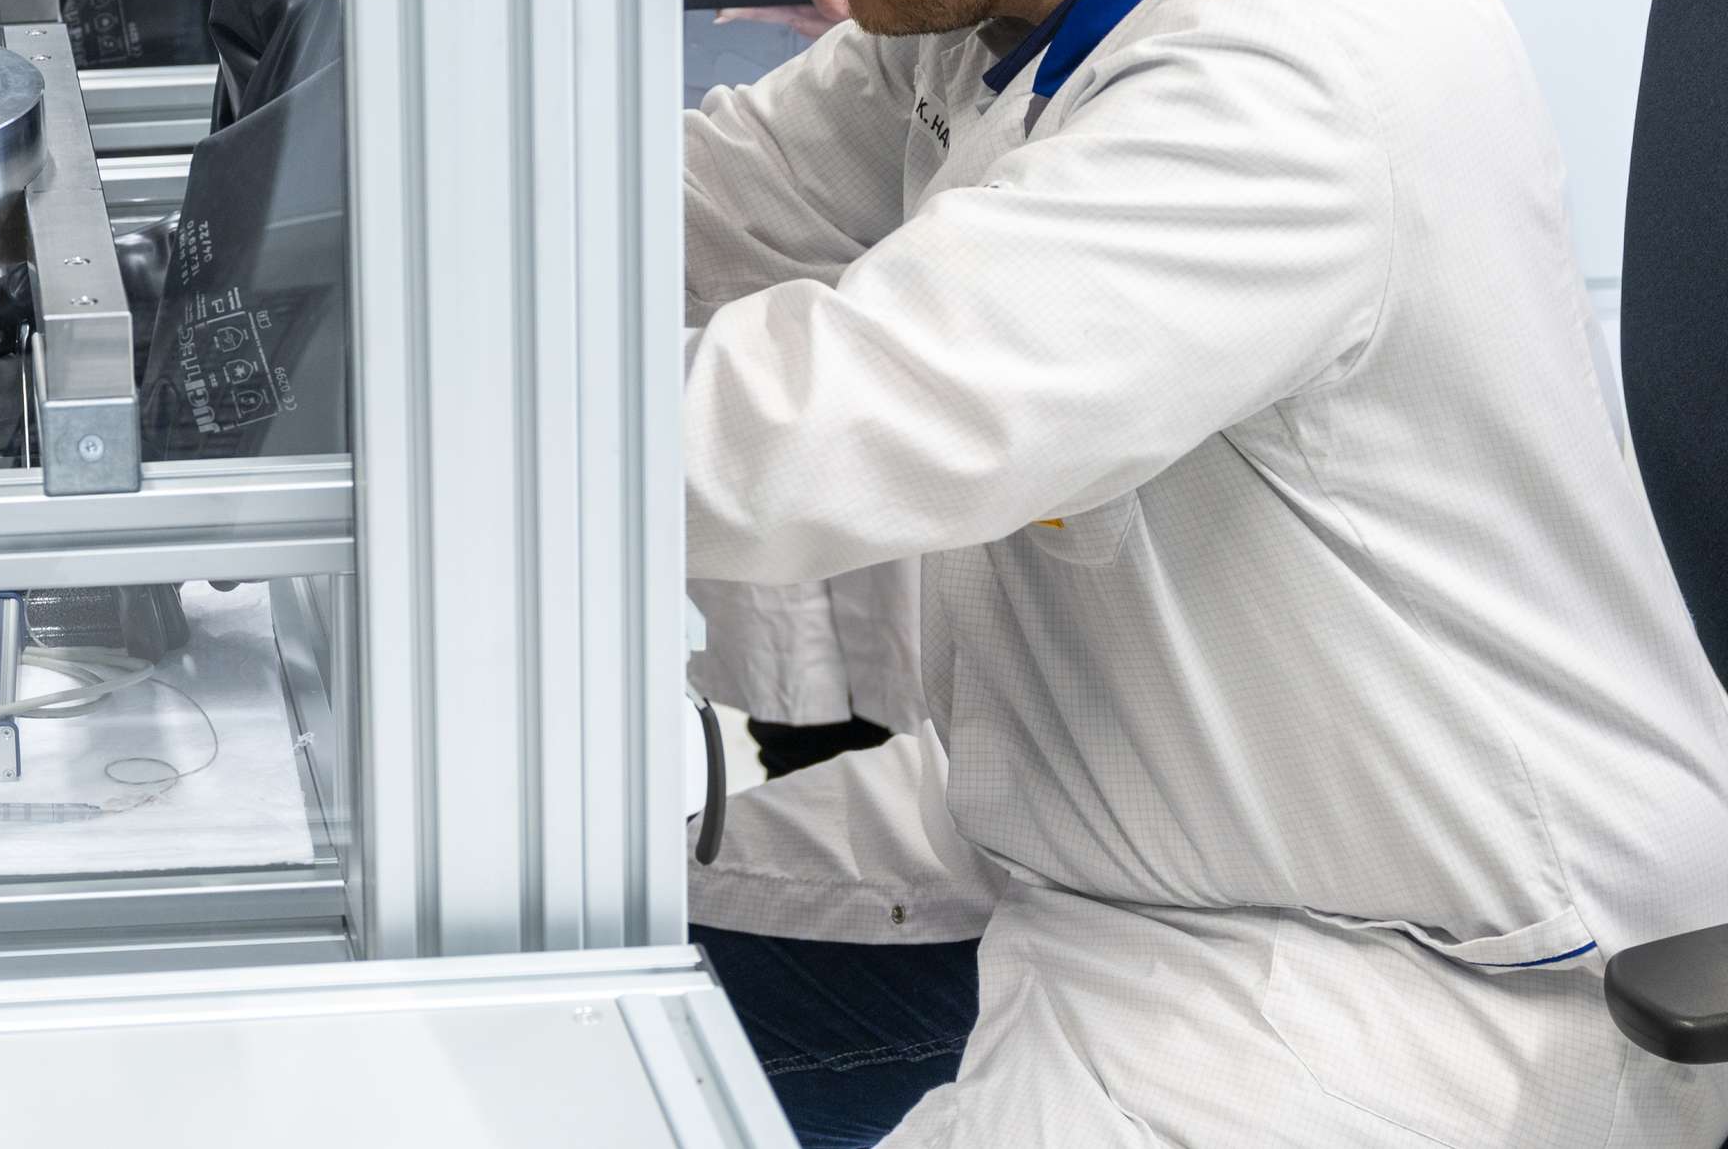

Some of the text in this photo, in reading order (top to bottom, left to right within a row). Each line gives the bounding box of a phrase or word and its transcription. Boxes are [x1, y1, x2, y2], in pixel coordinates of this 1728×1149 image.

[916, 97, 950, 149] K. HA
[177, 324, 221, 434] JUGITEC
[274, 366, 290, 392] 0299
